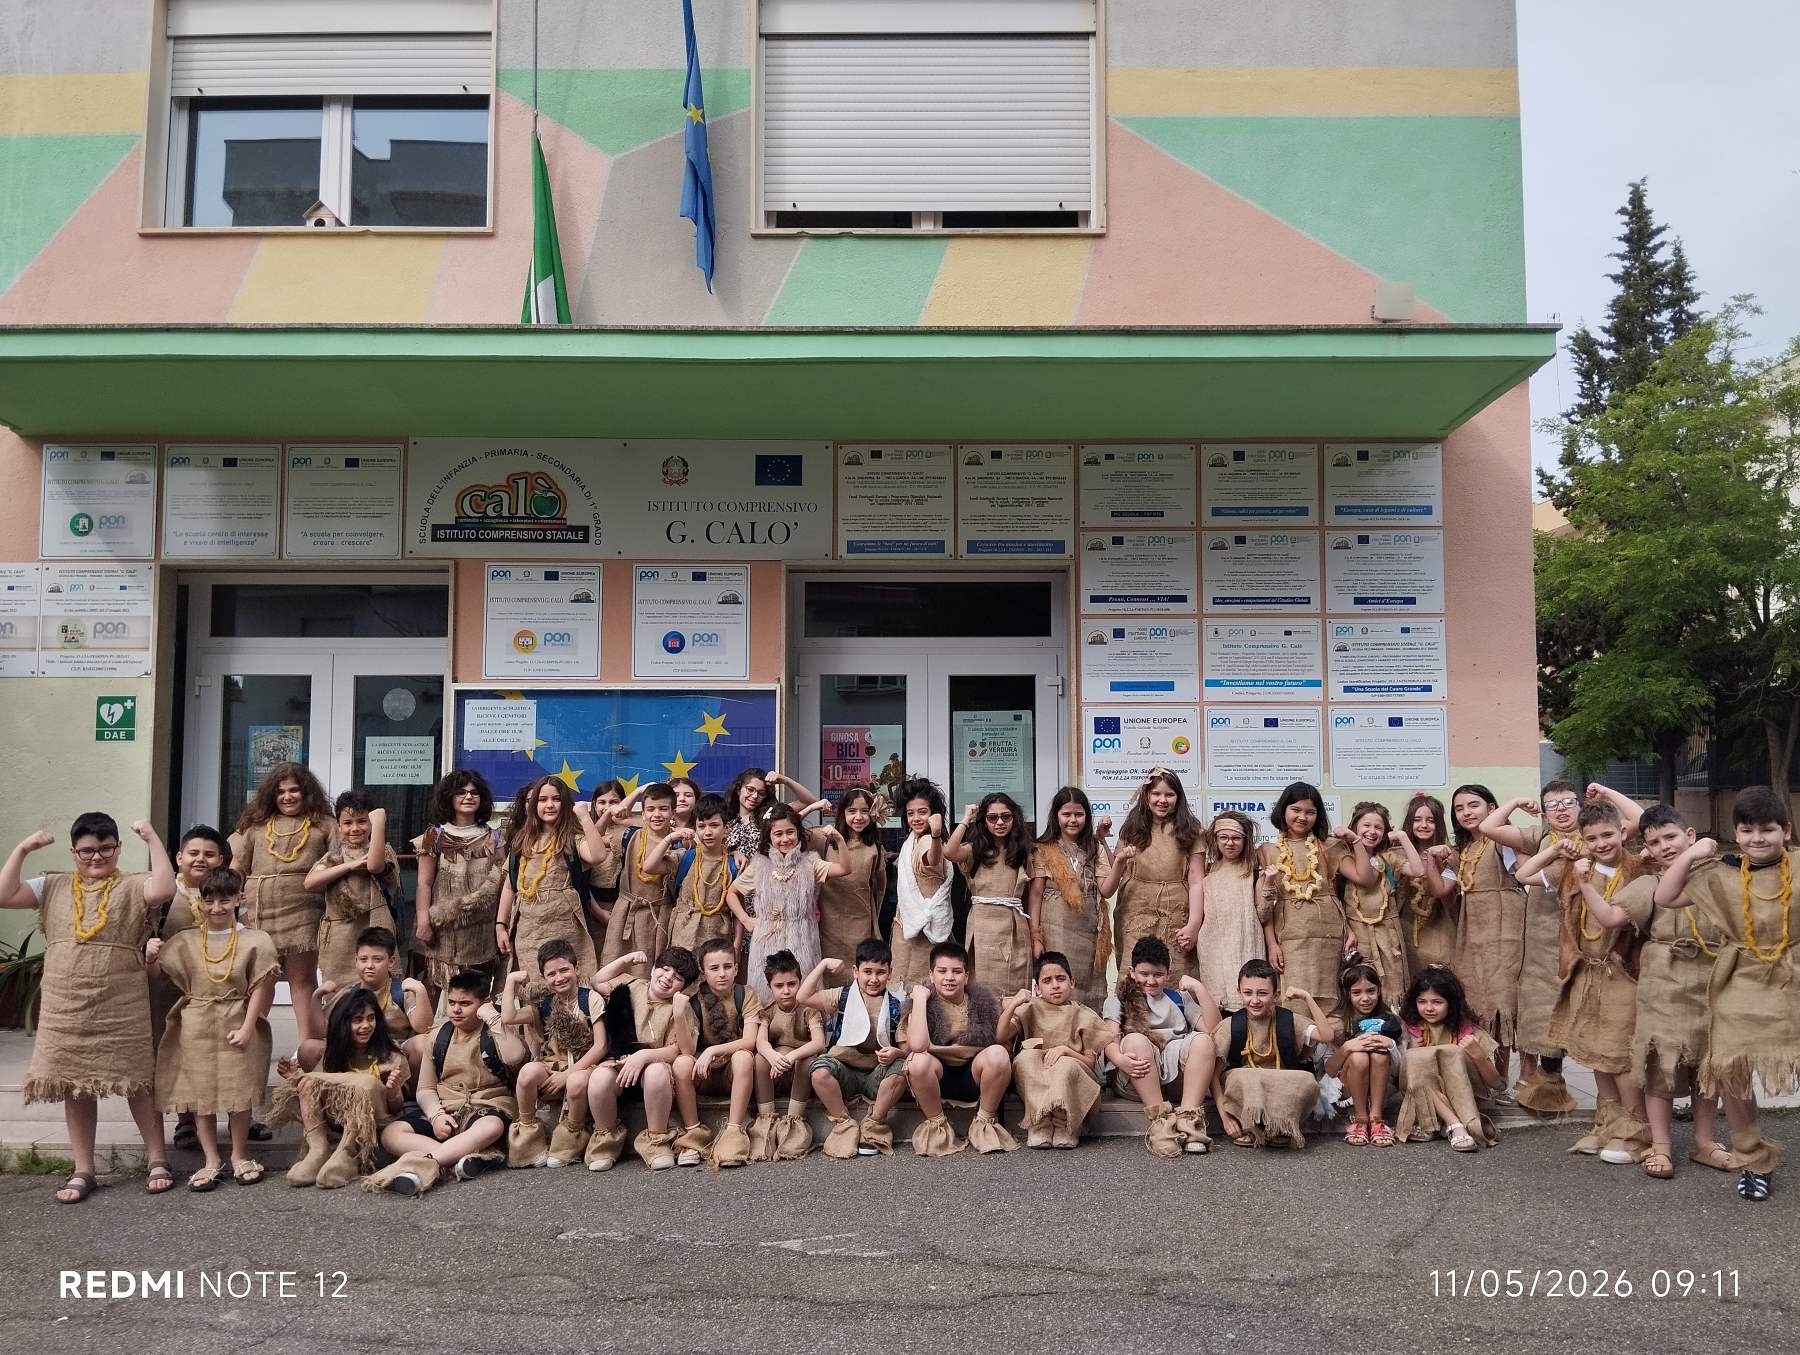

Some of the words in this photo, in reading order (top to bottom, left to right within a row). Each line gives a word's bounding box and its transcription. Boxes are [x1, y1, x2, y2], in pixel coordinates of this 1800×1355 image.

[49, 450, 69, 462] pon
[906, 450, 923, 460] pon
[1026, 450, 1043, 460] pon
[170, 457, 190, 468] pon
[292, 457, 312, 468] pon
[419, 506, 432, 544] SCUOLA
[427, 456, 478, 506] DELL'INFANZIA
[484, 448, 529, 459] PRIMARIA
[536, 452, 587, 490] SECONDARIA
[584, 490, 592, 501] DI
[592, 512, 602, 546] GRADO
[648, 500, 713, 512] ISTITUTO
[717, 501, 818, 513] COMPRENSIVO
[98, 515, 126, 529] pon
[437, 529, 477, 539] ISTITUTO
[478, 529, 544, 540] COMPRENSIVO
[546, 530, 584, 540] STATALE
[666, 520, 694, 544] G.
[1148, 536, 1165, 547] pon
[1271, 535, 1288, 546] pon
[1393, 535, 1411, 545] pon
[492, 570, 511, 581] pon
[640, 571, 659, 581] pon
[93, 622, 126, 638] pon
[1150, 628, 1168, 640] pon
[1336, 626, 1354, 636] pon
[544, 632, 570, 646] pon
[692, 632, 718, 647] pon
[1211, 717, 1230, 728] pon
[1335, 717, 1354, 728] pon
[104, 731, 126, 740] DAE
[831, 733, 859, 742] GINOSA
[836, 743, 859, 757] BICI
[1093, 738, 1121, 754] pon
[828, 764, 843, 780] 10
[1213, 802, 1266, 812] FUTURA
